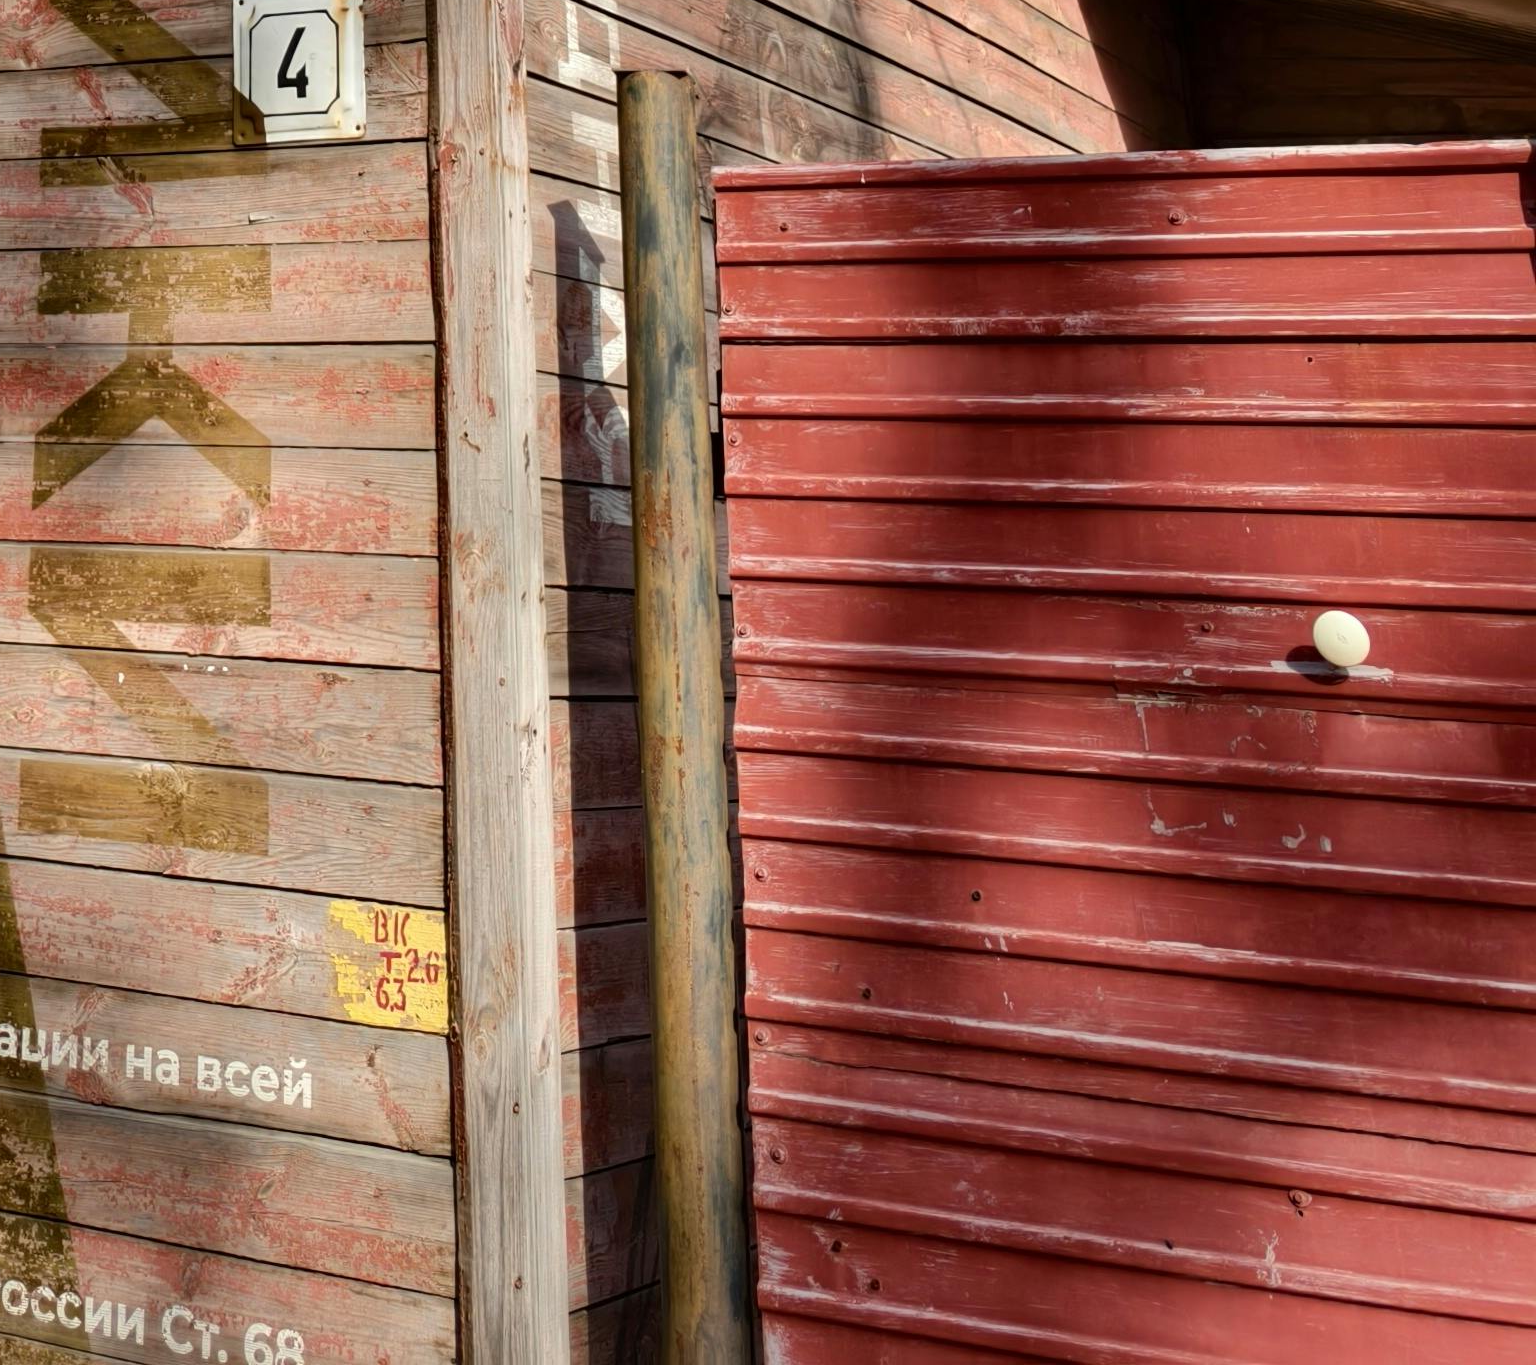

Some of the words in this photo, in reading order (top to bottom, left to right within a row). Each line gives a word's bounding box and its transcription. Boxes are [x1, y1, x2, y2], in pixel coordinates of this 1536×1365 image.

[277, 27, 309, 98] 4
[125, 1042, 181, 1086] на
[196, 1054, 313, 1109] всей
[161, 1303, 228, 1363] Ст.
[244, 1322, 305, 1365] 68
